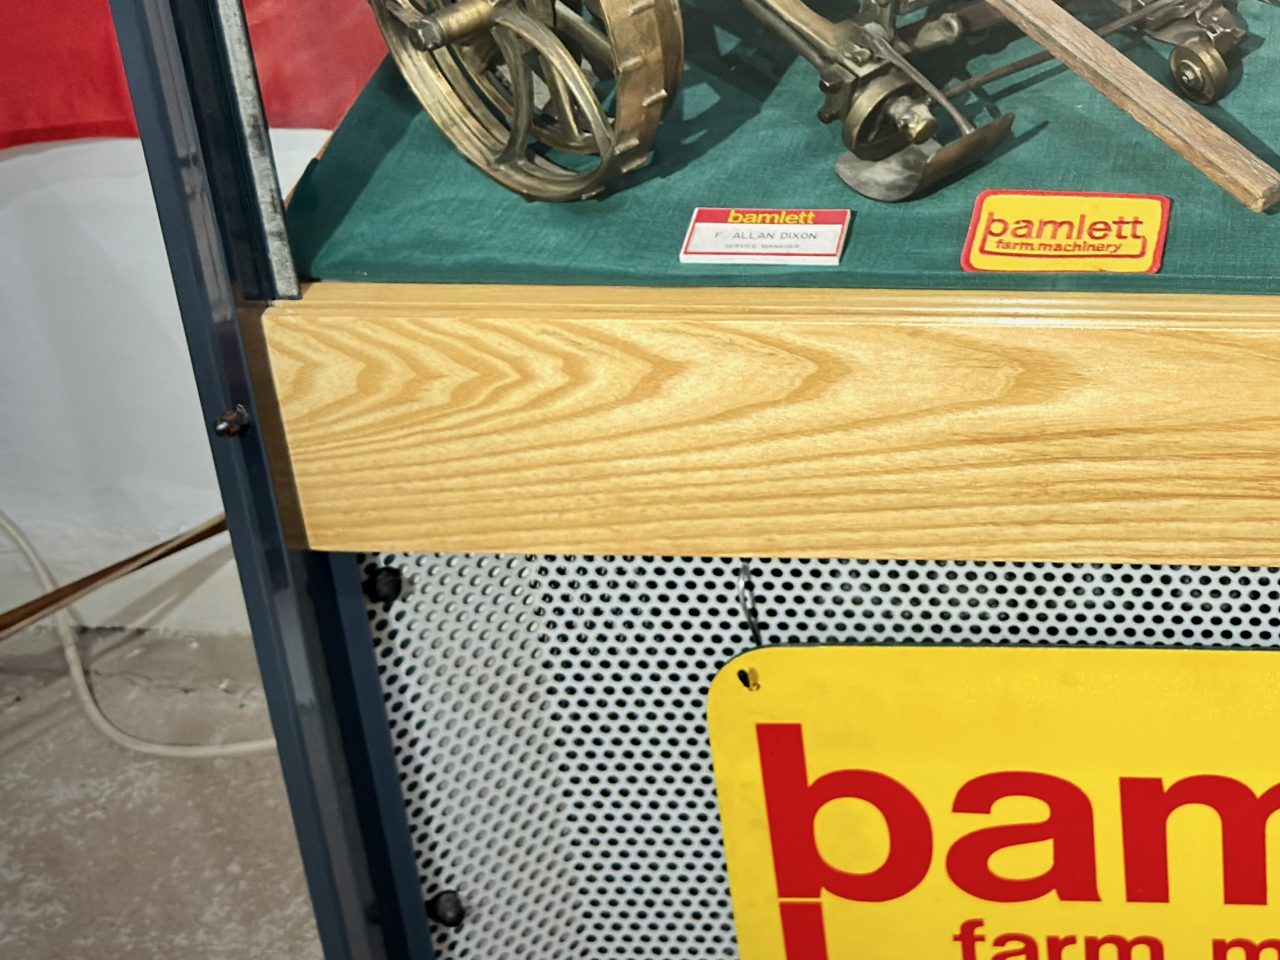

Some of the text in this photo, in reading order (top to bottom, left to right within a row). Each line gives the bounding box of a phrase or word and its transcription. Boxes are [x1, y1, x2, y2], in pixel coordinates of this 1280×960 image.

[727, 209, 816, 225] bamlett
[986, 211, 1144, 241] bamlett
[732, 231, 775, 240] ALLAN
[780, 232, 818, 240] DIXON
[995, 239, 1123, 254] farm machinery
